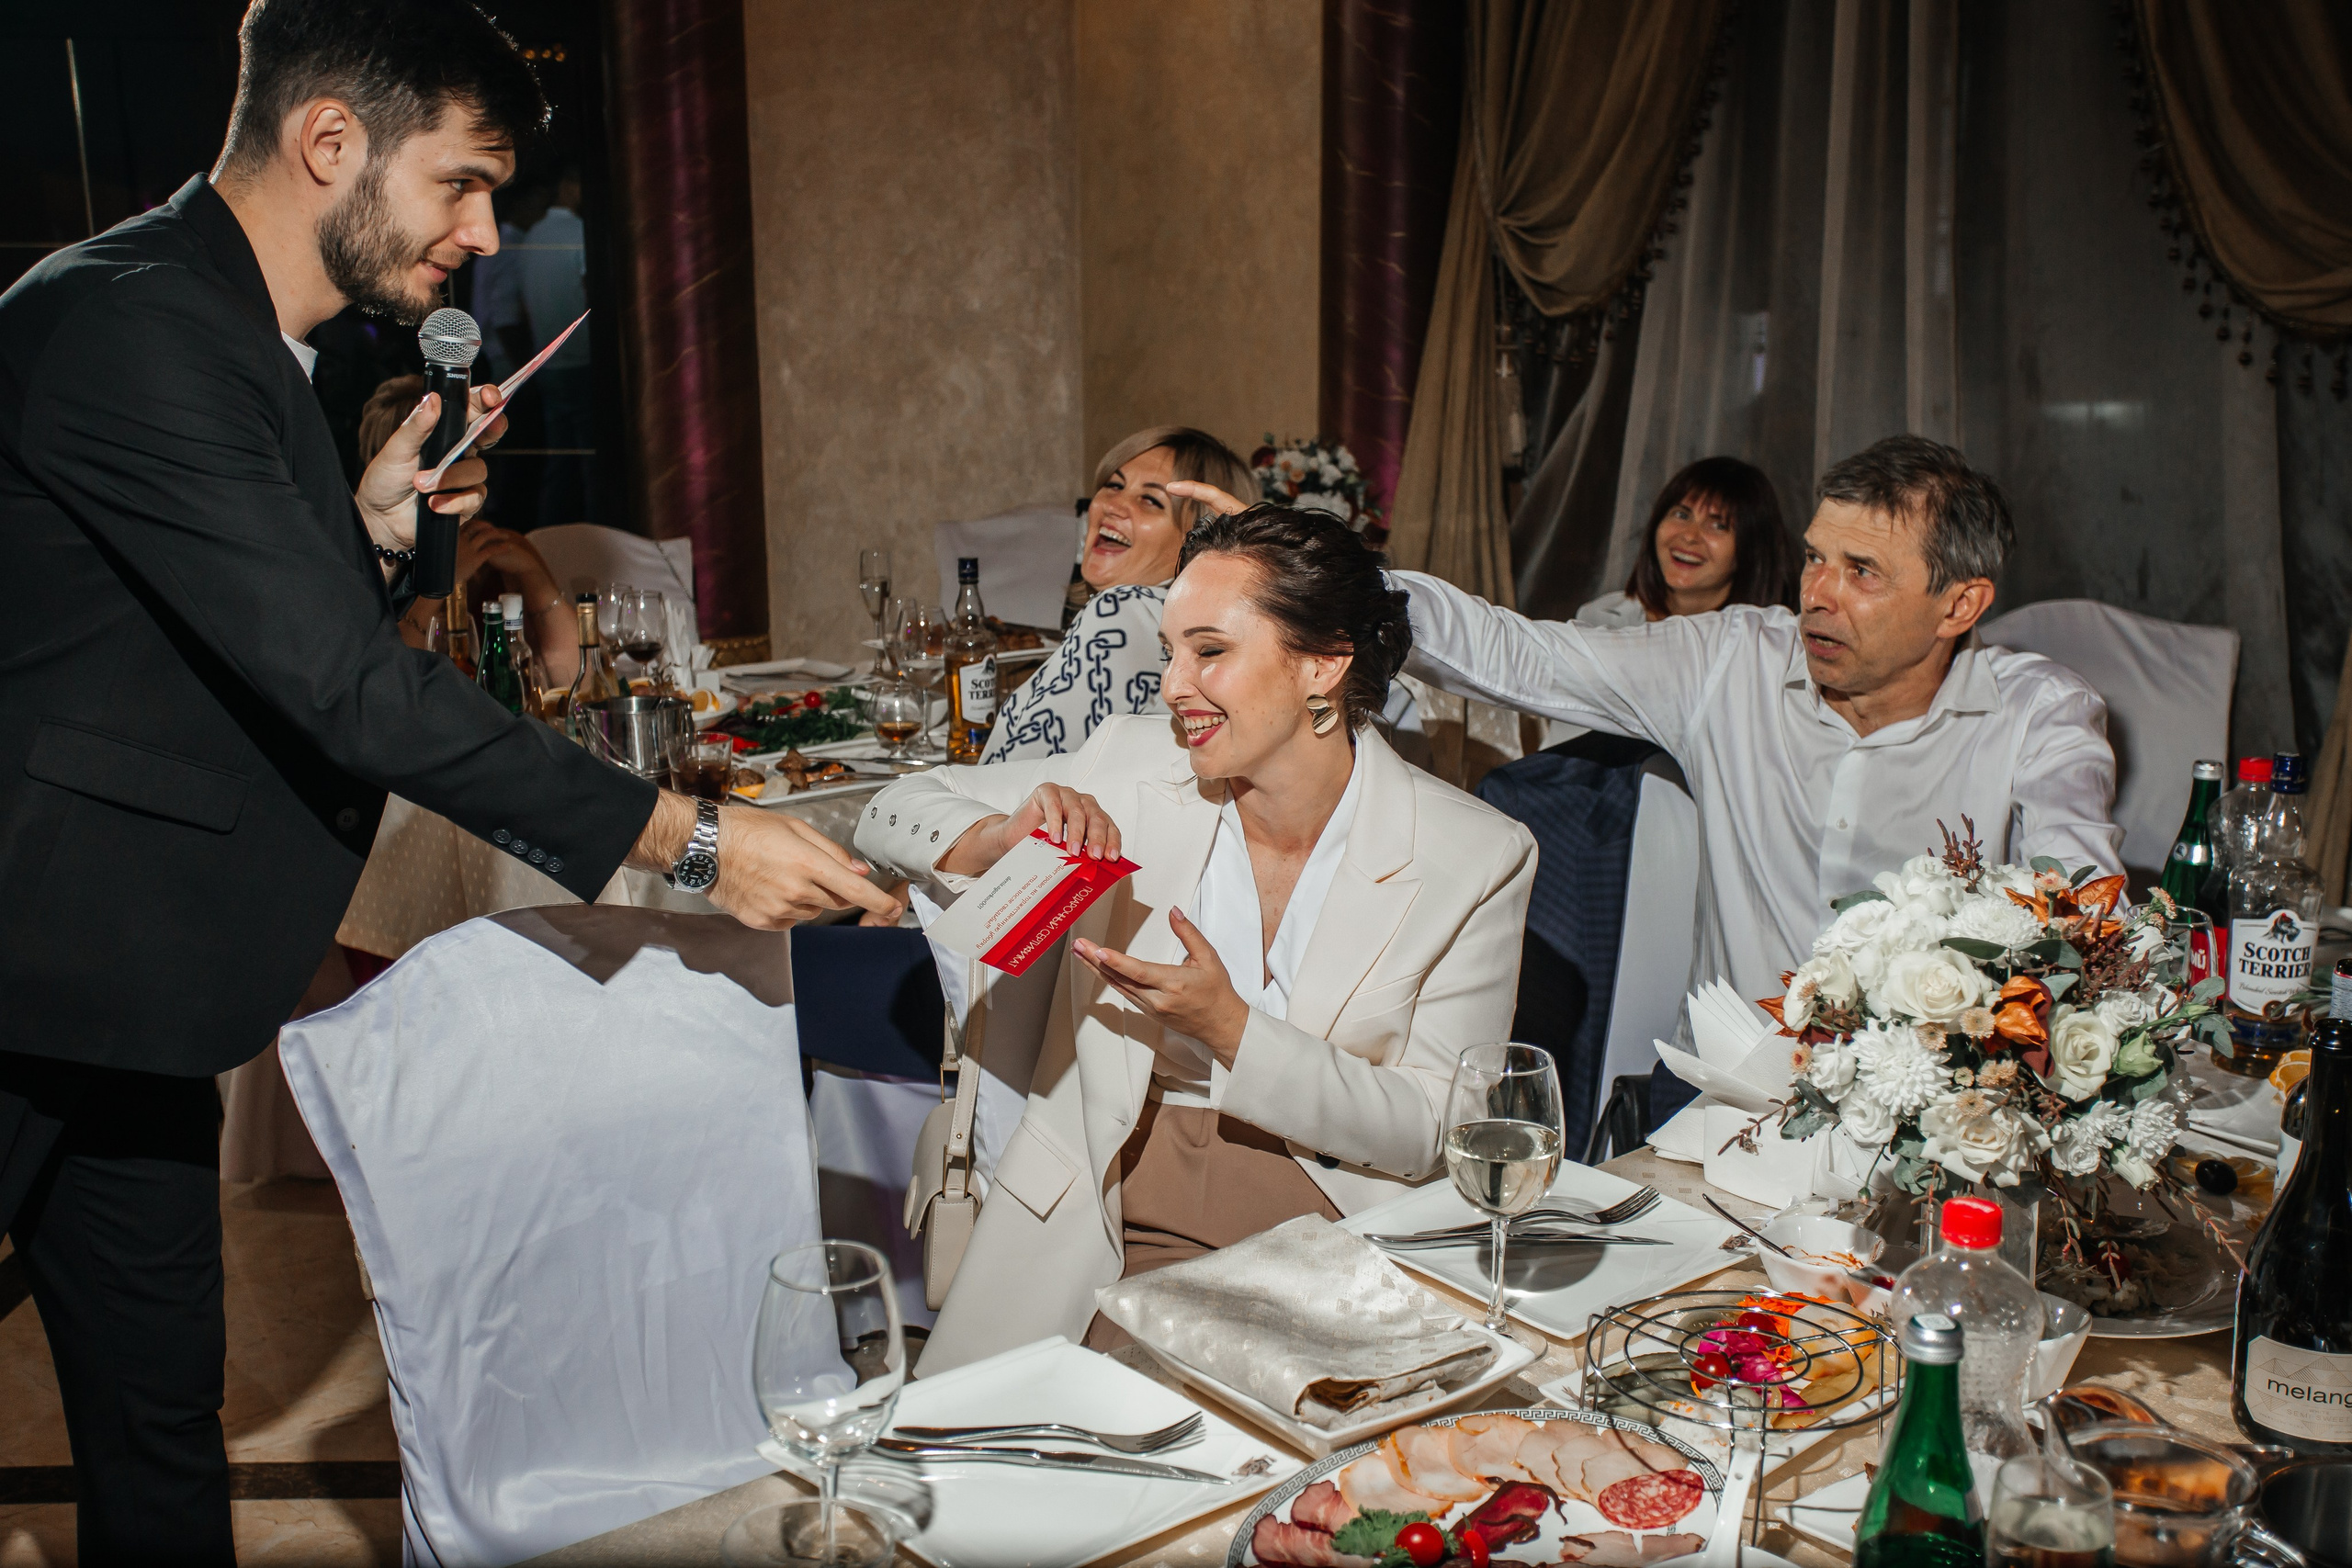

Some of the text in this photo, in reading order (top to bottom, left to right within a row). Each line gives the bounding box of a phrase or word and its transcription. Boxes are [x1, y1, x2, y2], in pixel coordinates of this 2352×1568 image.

[1021, 874, 1037, 890] столов
[1008, 889, 1022, 904] после
[994, 896, 1031, 931] торжественную
[1008, 885, 1093, 967] ПОДАРОЧНЫЙ СЕРТИФИКАТ
[976, 931, 994, 949] уборку
[2244, 942, 2312, 961] SCOTCH
[2239, 958, 2311, 978] TERRIER
[2267, 1379, 2352, 1408] melang
